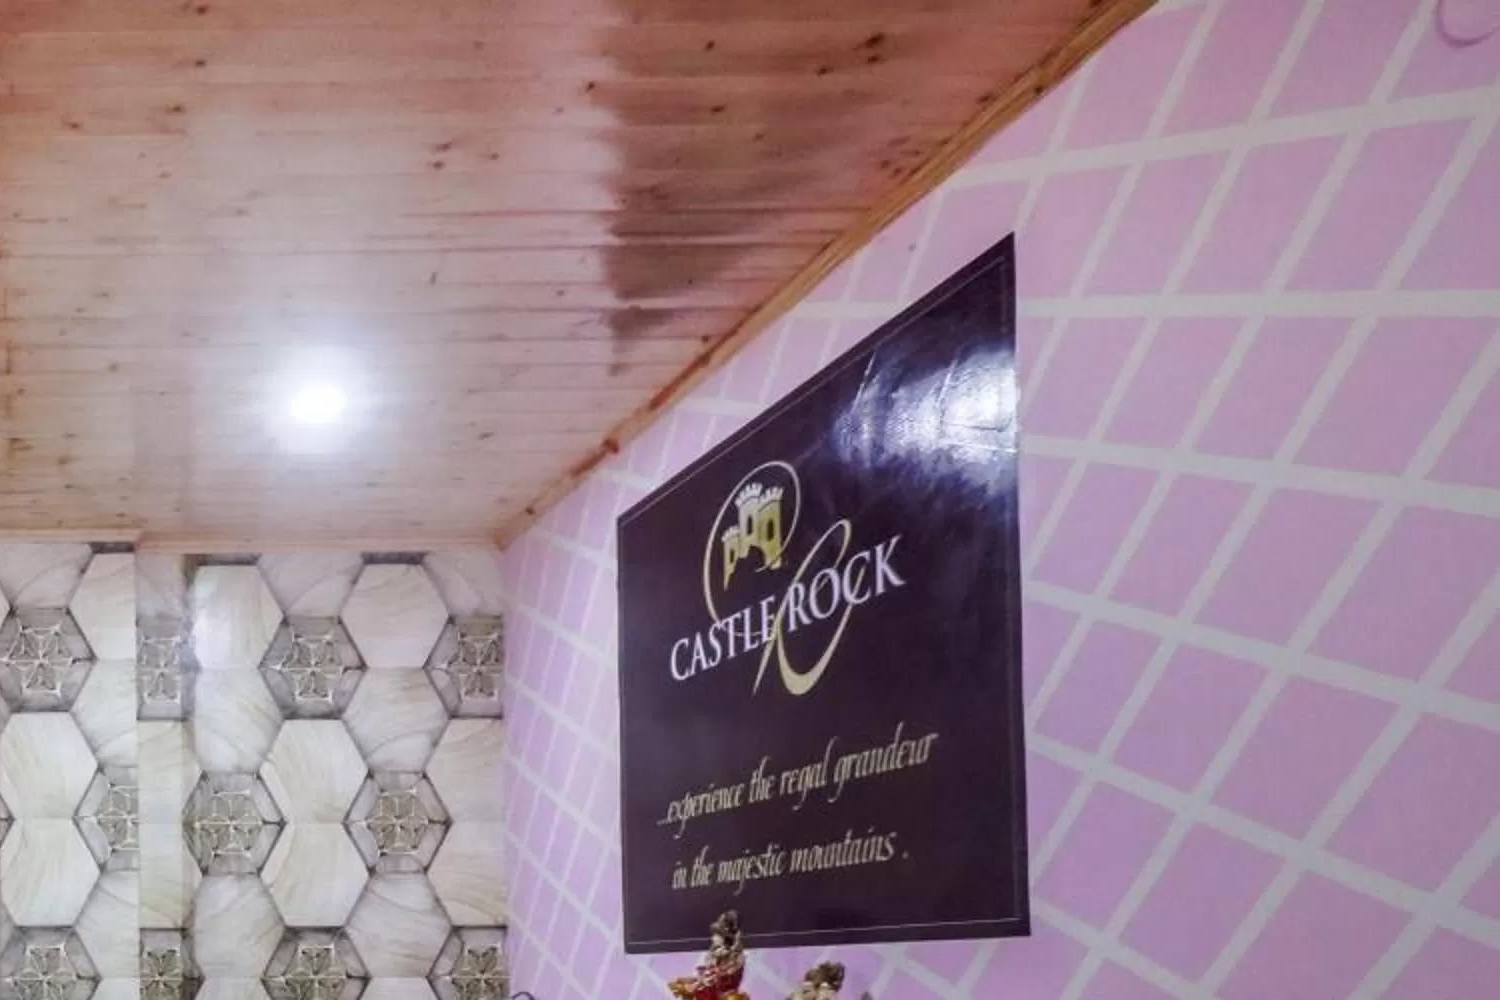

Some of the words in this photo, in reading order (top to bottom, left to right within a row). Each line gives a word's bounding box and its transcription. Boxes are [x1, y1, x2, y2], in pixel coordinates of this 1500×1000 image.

[670, 595, 777, 681] CASTLE
[787, 534, 907, 633] ROCK
[748, 755, 776, 804] the
[779, 735, 840, 811] regal
[827, 720, 940, 803] grandeur
[671, 861, 688, 890] in
[690, 845, 714, 888] the
[717, 842, 786, 897] majestic
